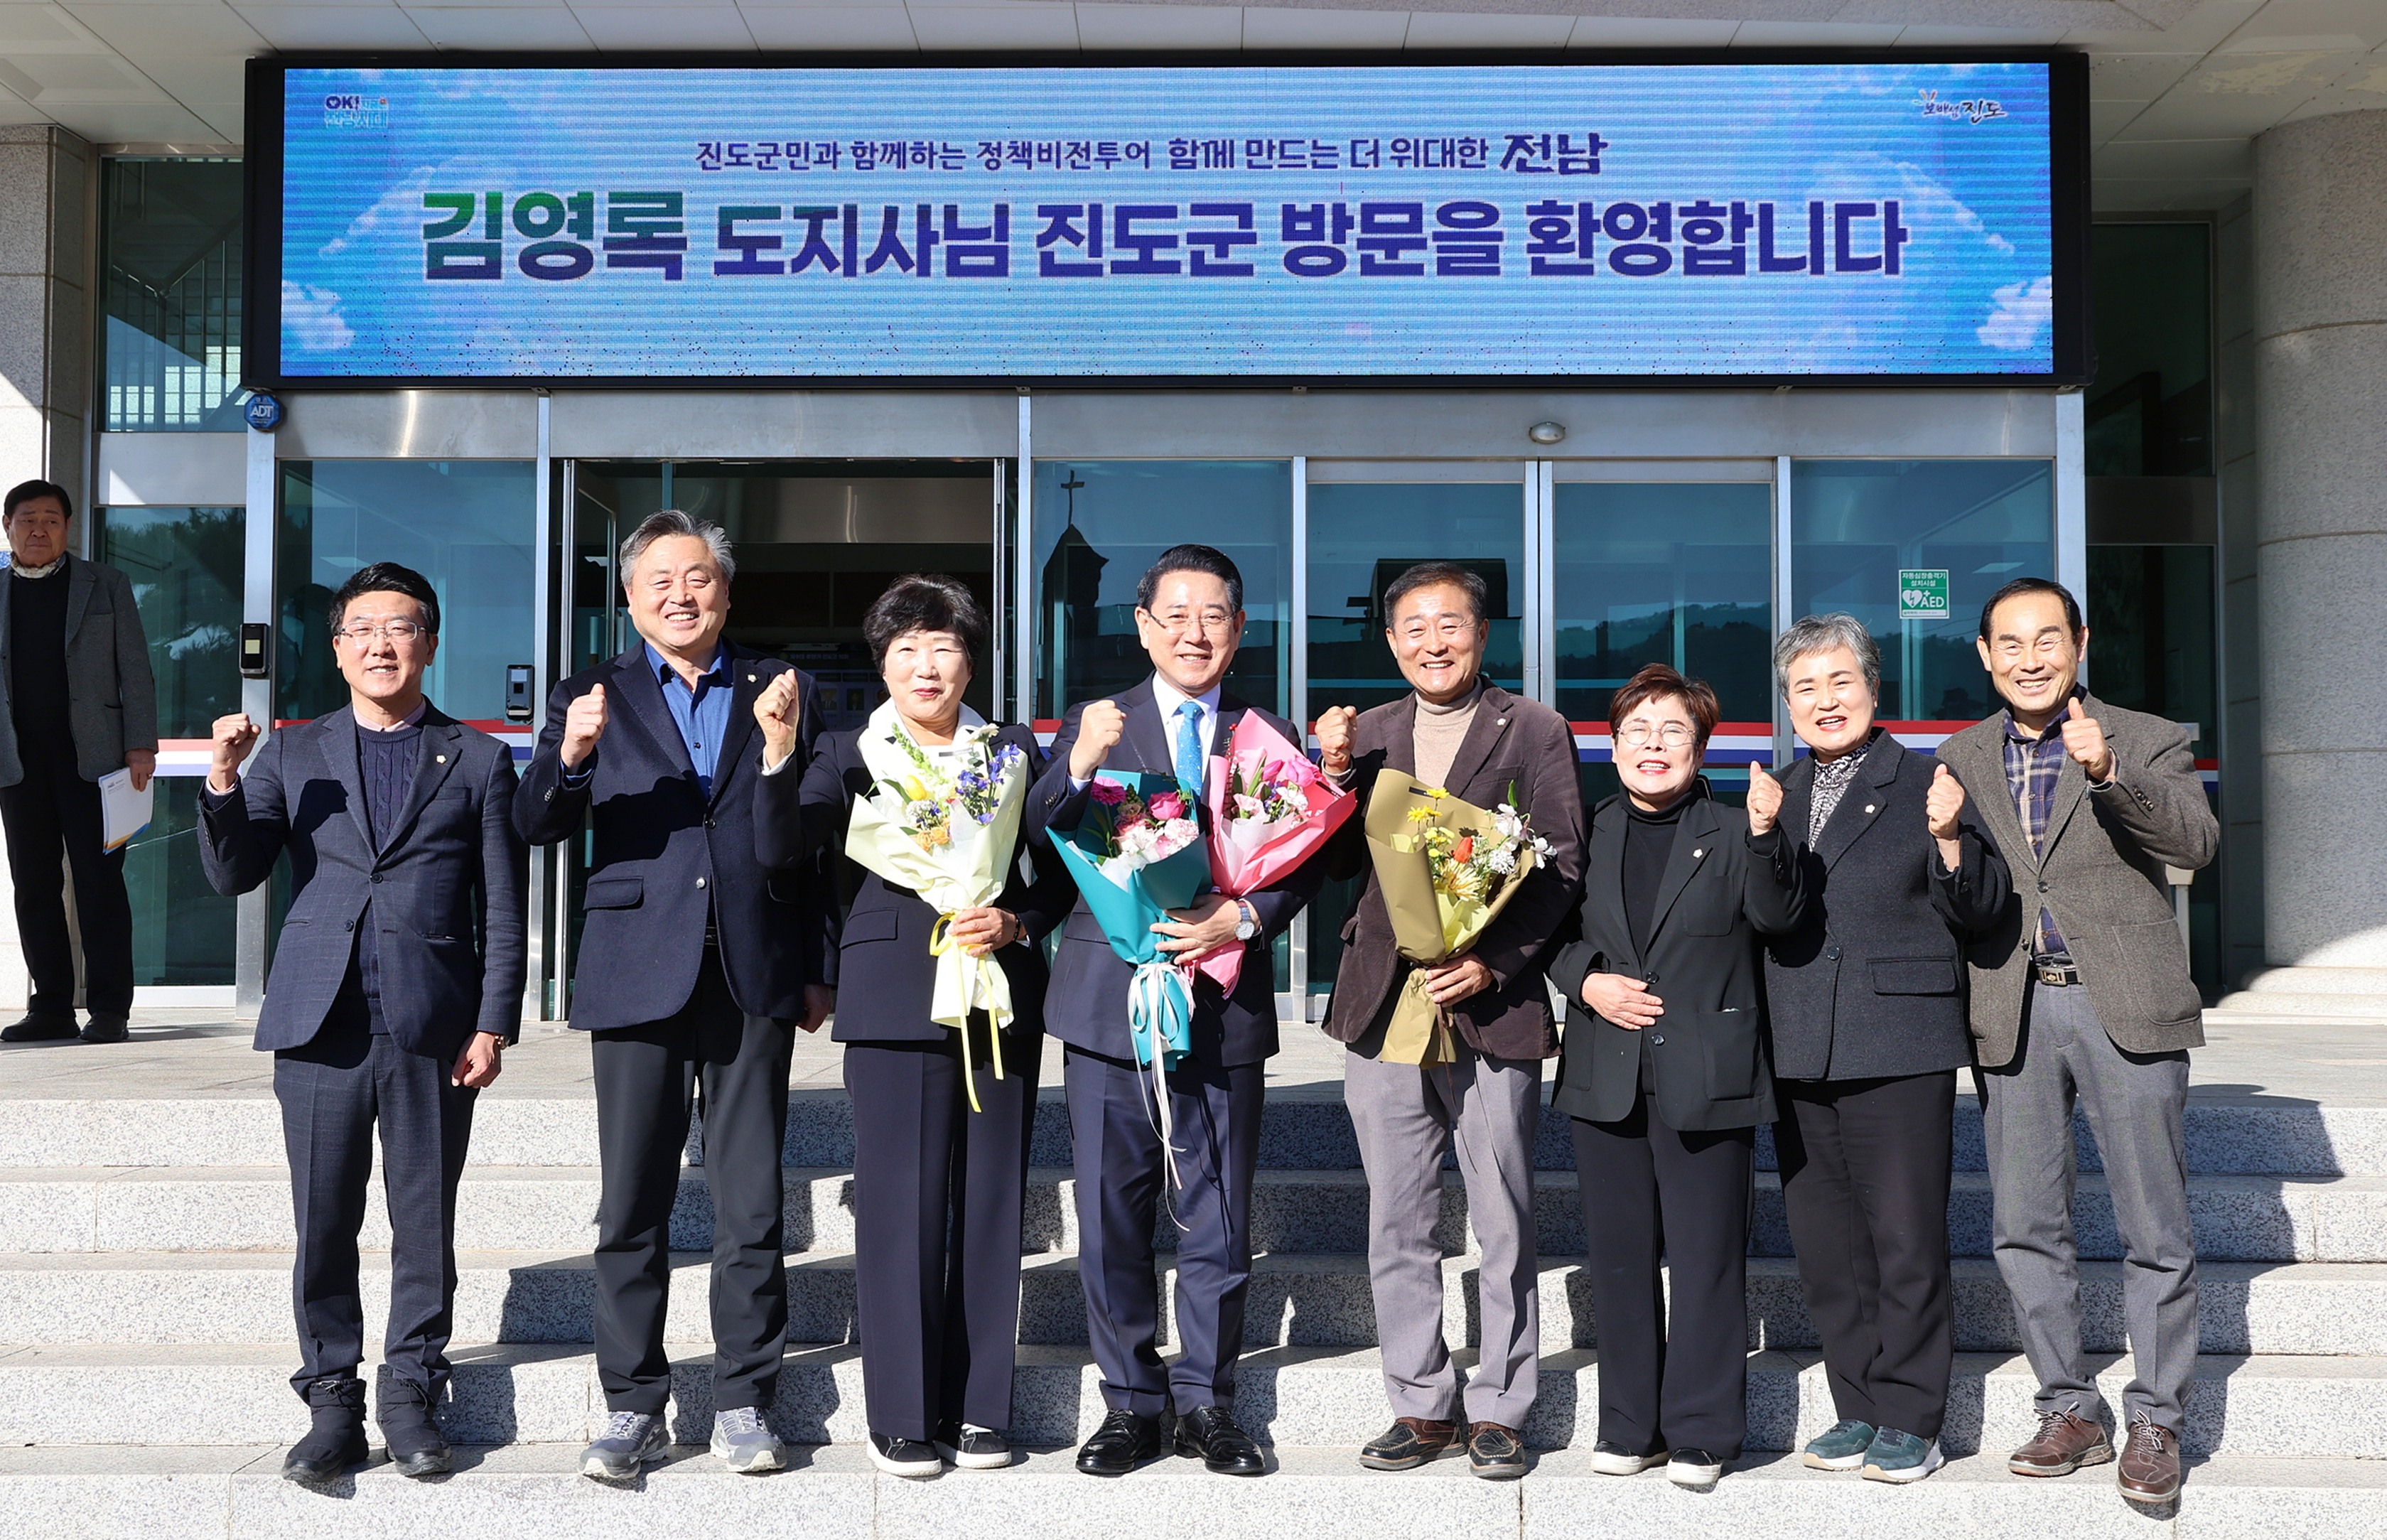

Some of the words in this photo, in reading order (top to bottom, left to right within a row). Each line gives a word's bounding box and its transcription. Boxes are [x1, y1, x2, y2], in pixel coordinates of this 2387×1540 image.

[1961, 99, 2006, 124] 진도
[696, 141, 842, 171] 진도군민과
[849, 141, 966, 171] 함께하는
[976, 140, 1151, 171] 정책비전투어
[1168, 137, 1235, 170] 함께
[1245, 139, 1340, 170] 만드는
[1350, 138, 1380, 168] 더
[1389, 136, 1489, 169] 위대한
[1499, 133, 1608, 176] 전남
[423, 191, 688, 281] 김영록
[713, 203, 1010, 278] 도지사님
[1035, 203, 1258, 278] 진도군
[1281, 202, 1504, 278] 방문을
[1526, 199, 1908, 277] 환영합니다
[250, 405, 274, 417] ADT
[1920, 596, 1945, 608] AED
